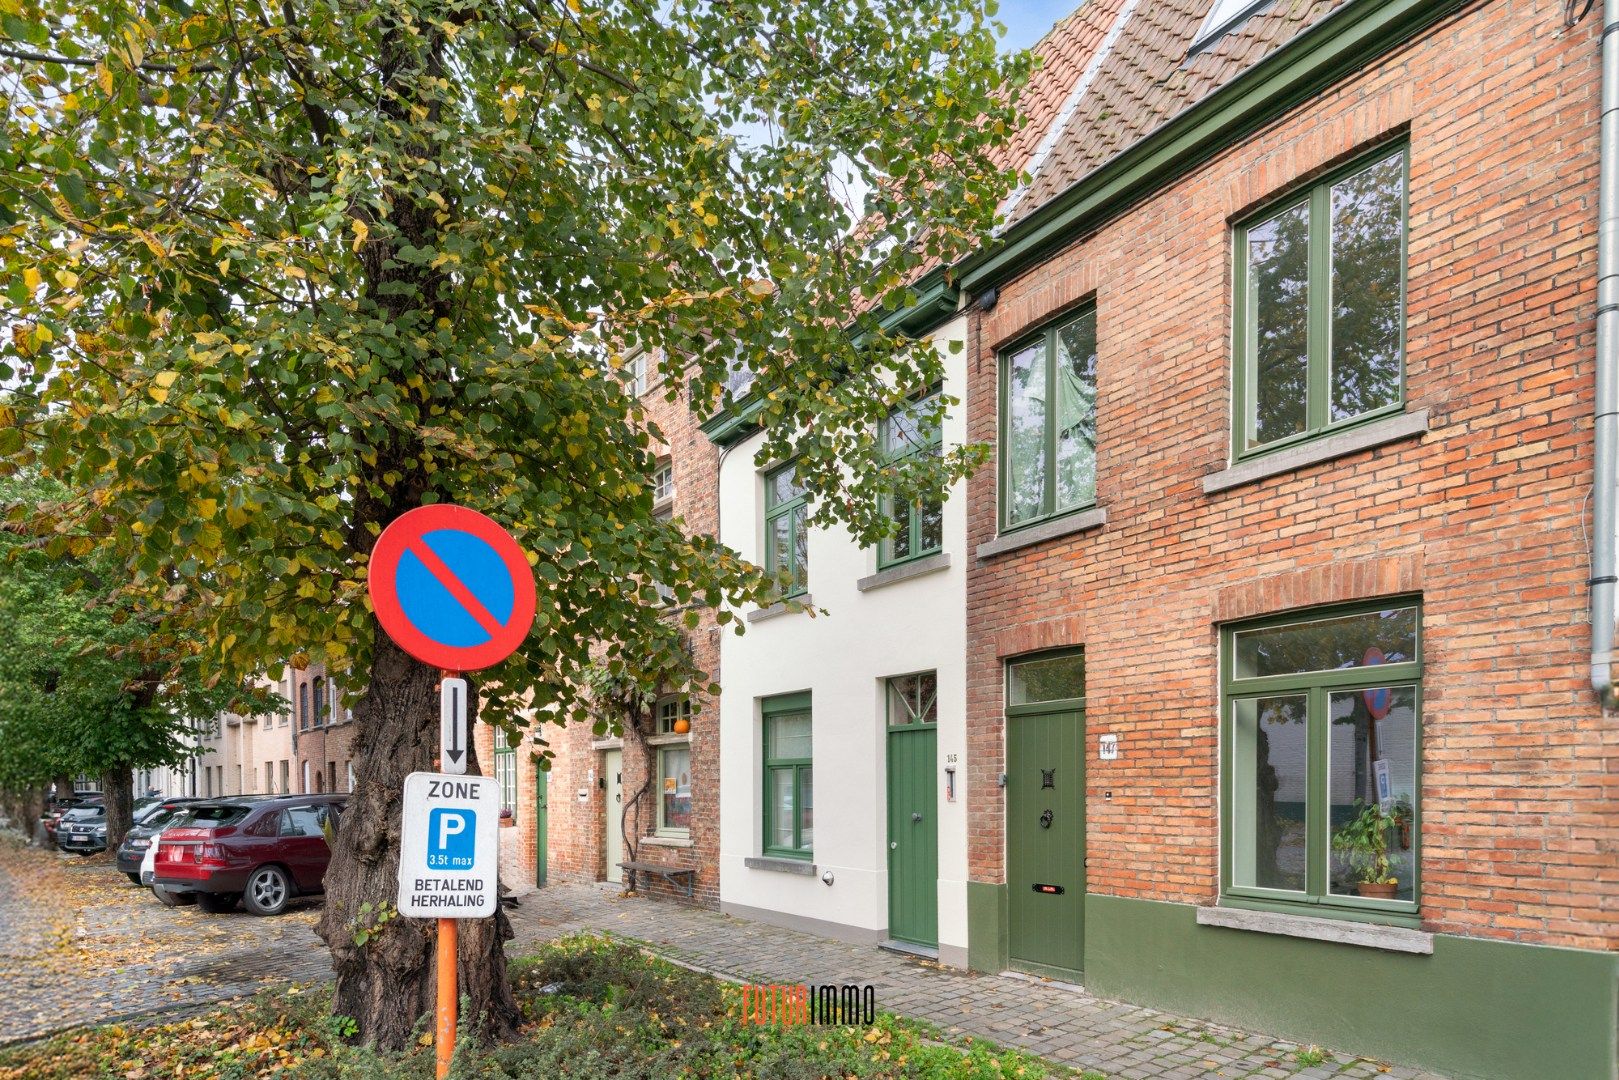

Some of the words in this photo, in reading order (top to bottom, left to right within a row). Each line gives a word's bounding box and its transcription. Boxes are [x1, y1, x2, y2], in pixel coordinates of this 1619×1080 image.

[1102, 742, 1116, 755] 147
[947, 754, 958, 763] 145
[428, 780, 481, 800] ZONE
[438, 812, 466, 850] P
[429, 854, 449, 866] 3.5t
[452, 855, 472, 866] max
[414, 878, 484, 891] BETALEND
[411, 894, 485, 907] HERHALING
